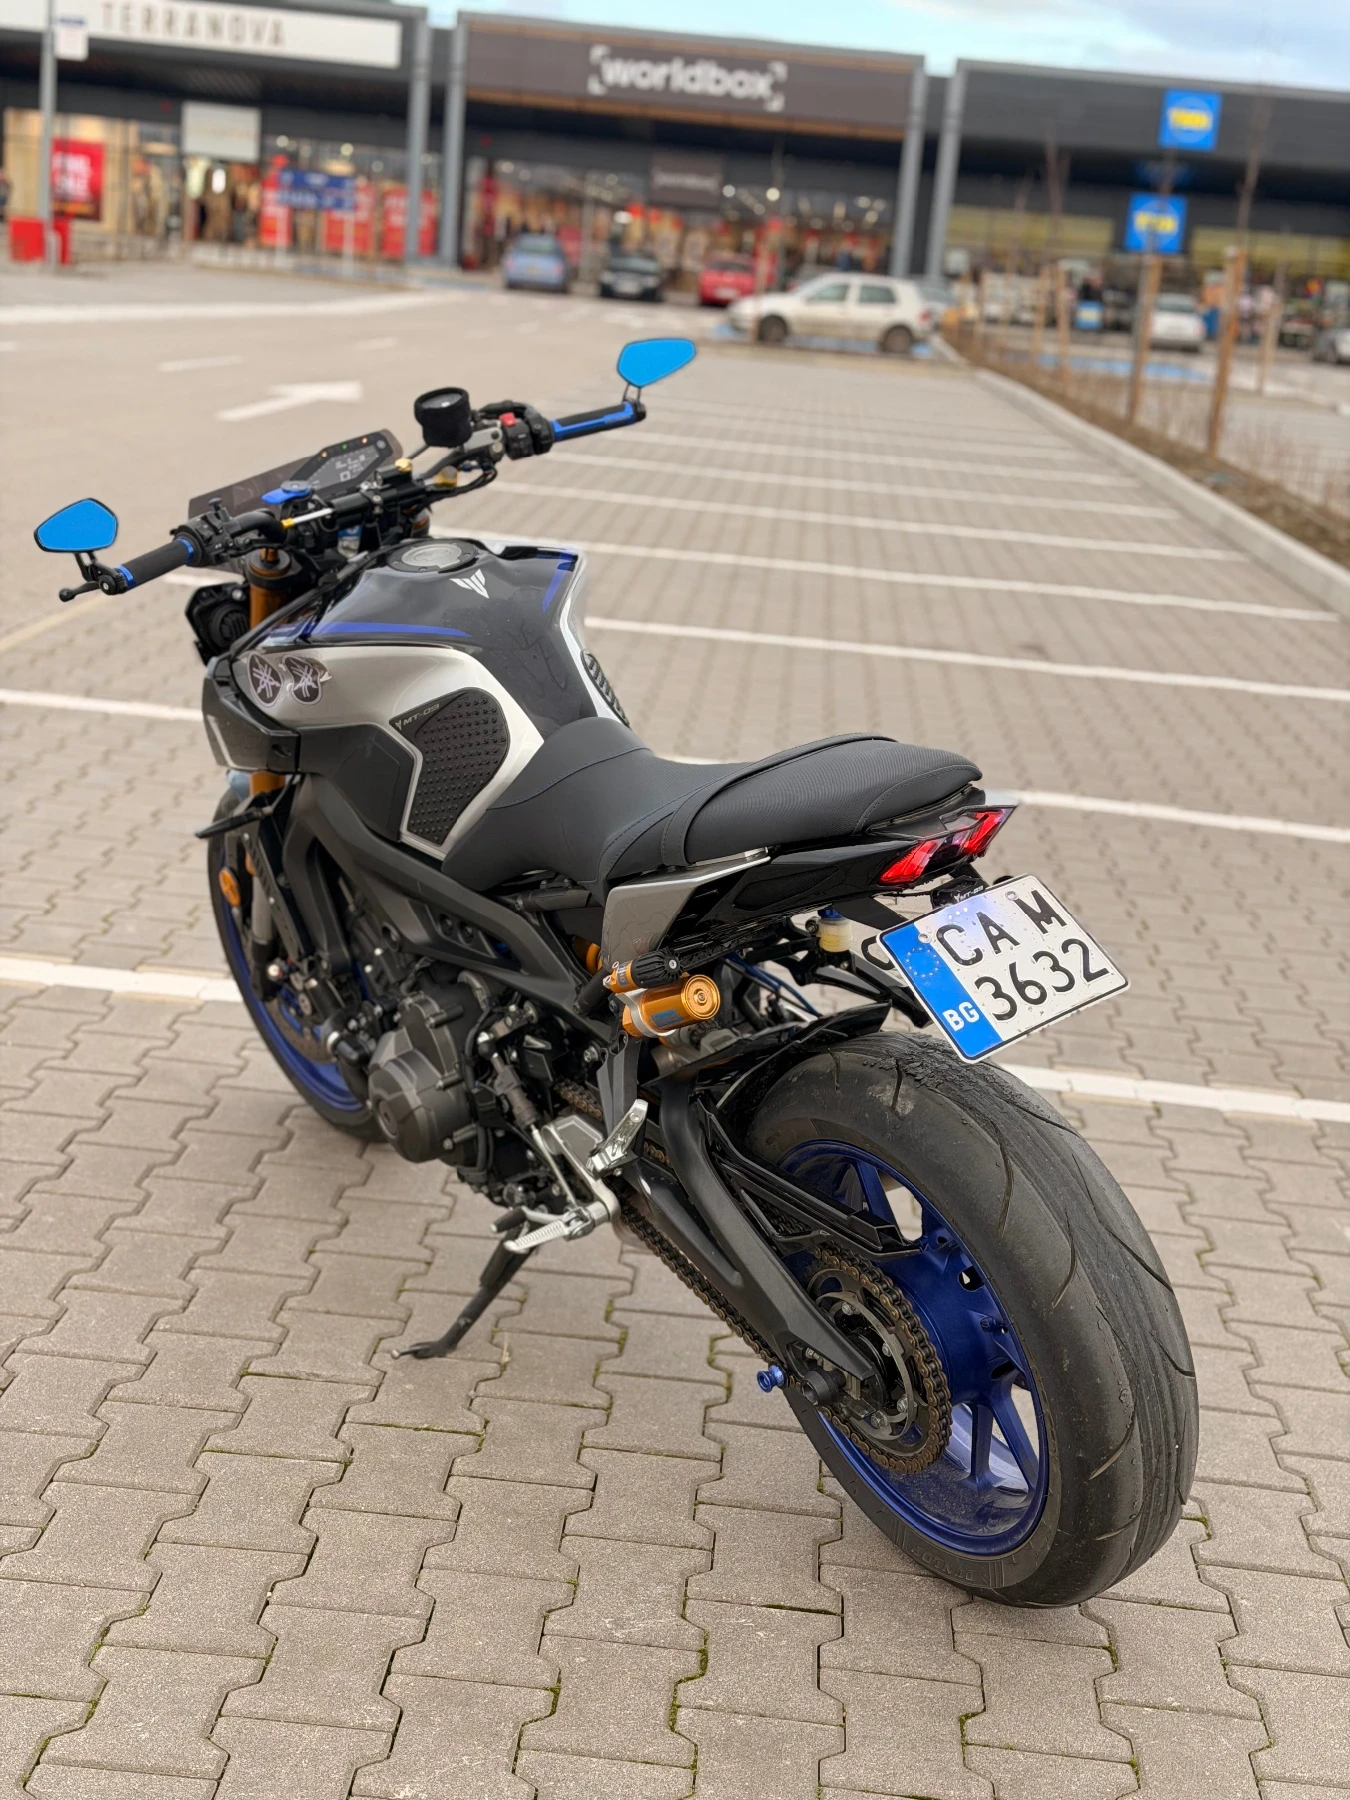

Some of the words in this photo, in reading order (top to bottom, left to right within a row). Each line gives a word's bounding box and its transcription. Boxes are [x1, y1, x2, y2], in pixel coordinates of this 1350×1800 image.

[103, 2, 287, 46] TERRANOVA
[600, 56, 776, 101] worldbox
[402, 703, 440, 726] MT-09
[1015, 889, 1068, 935] M
[975, 937, 1110, 1021] 3632
[942, 1001, 980, 1032] BG
